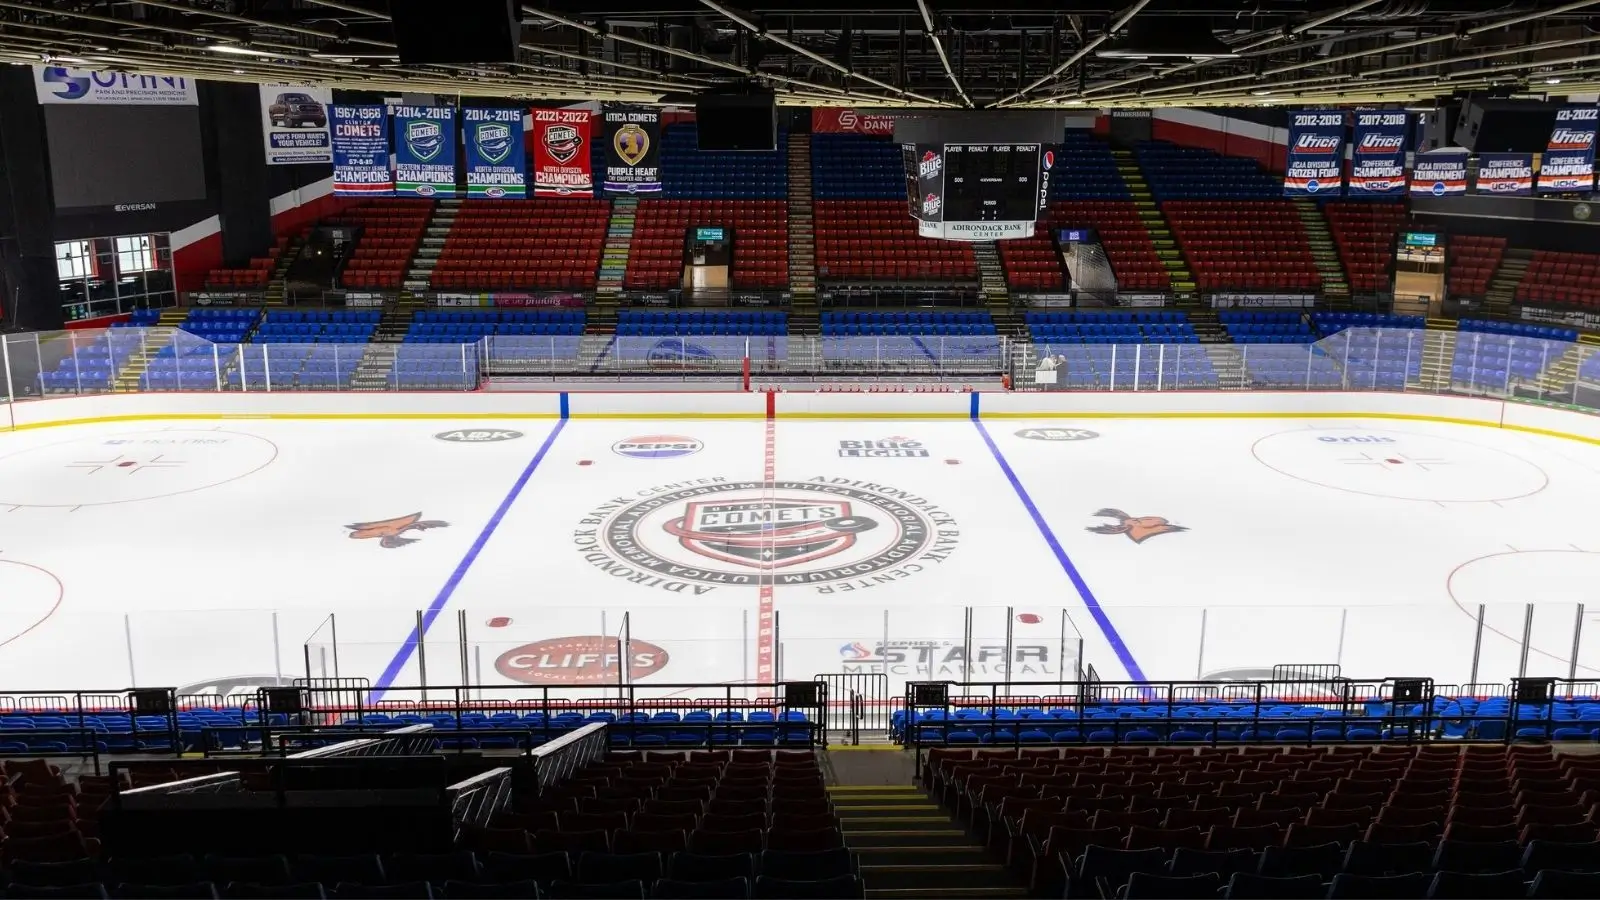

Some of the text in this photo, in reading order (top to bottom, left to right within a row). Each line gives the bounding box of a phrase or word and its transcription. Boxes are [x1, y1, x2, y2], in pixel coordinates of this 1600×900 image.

[335, 107, 381, 118] 1967-1968
[396, 106, 451, 119] 2014-2015
[465, 109, 520, 121] 2014-2015
[535, 110, 589, 122] 2021-2022
[1556, 109, 1598, 120] 21-2022
[605, 114, 657, 123] UTICA COMETS
[1295, 114, 1342, 126] 2012-2013
[1359, 114, 1406, 125] 2017-2018
[336, 124, 380, 137] COMETS
[864, 121, 894, 130] DANF
[411, 127, 438, 138] COMETS
[480, 129, 507, 140] COMETS
[549, 129, 575, 140] COMETS
[1433, 162, 1457, 170] DIVISION
[1488, 160, 1524, 168] CONFERENCE
[1550, 156, 1585, 165] CONFERENCE
[396, 163, 454, 172] WESTERN CONFERENCE
[607, 167, 658, 176] PURPLE HEART
[920, 158, 942, 176] Blue
[1288, 167, 1339, 177] FROZEN FOUR
[1354, 166, 1402, 177] CHAMPIONS
[1541, 164, 1592, 175] CHAMPIONS
[334, 171, 389, 182] CHAMPIONS
[396, 171, 454, 182] CHAMPIONS
[467, 173, 524, 184] CHAMPIONS
[535, 172, 590, 184] CHAMPIONS
[1413, 170, 1466, 180] TOURNAMENT
[1480, 167, 1531, 179] CHAMPIONS
[1040, 171, 1049, 210] pepsi
[1491, 183, 1518, 191] UCHC
[119, 203, 156, 211] EVERSAN
[923, 199, 941, 213] Blue
[525, 297, 560, 306] printing
[840, 439, 922, 449] Blue
[840, 449, 928, 457] LIGHT
[711, 503, 771, 512] UTICA
[701, 506, 836, 526] COMETS
[574, 476, 727, 595] ADIRONDACK BANK CENTER
[612, 483, 756, 583] UTICA MEMORIAL AUDITORIUM
[783, 483, 922, 582] UTICA MEMORIAL AUDITORIUM
[808, 475, 960, 595] ADIRONDACK BANK CENTER
[874, 646, 1048, 663] STARR
[507, 654, 656, 668] CLIFFS
[527, 670, 567, 680] LOCAL
[843, 664, 1055, 676] MECHANICAL
